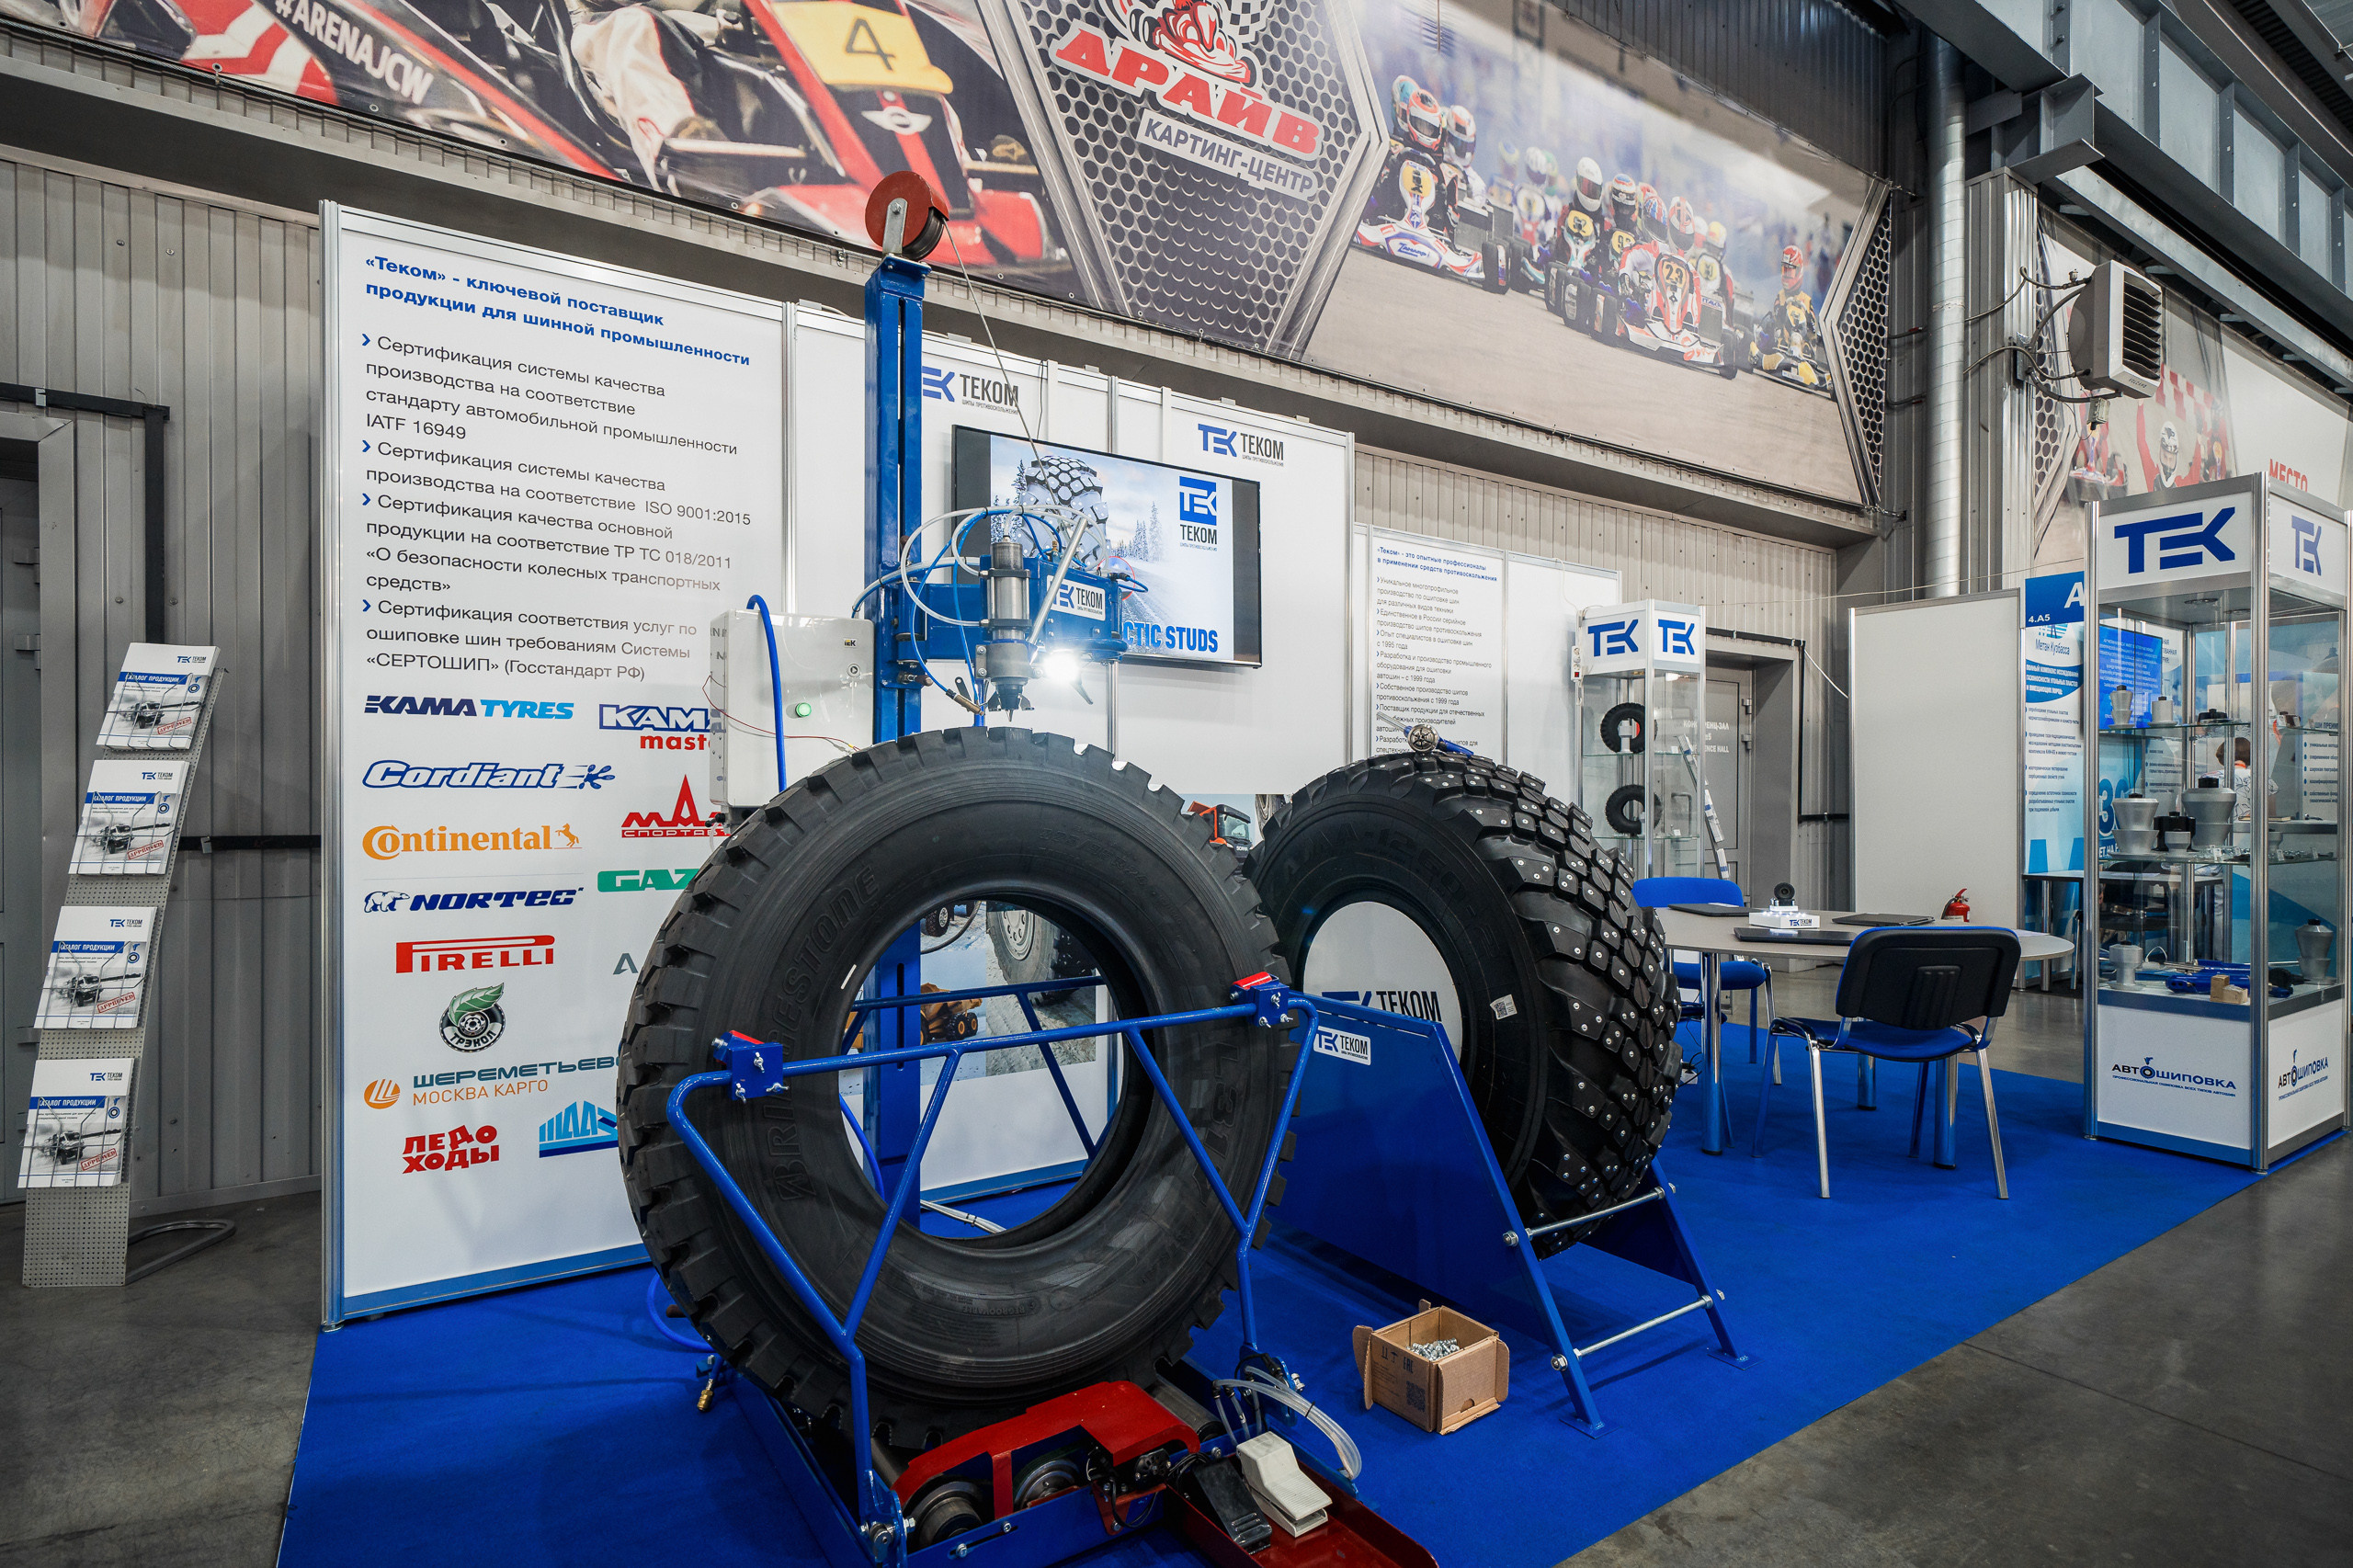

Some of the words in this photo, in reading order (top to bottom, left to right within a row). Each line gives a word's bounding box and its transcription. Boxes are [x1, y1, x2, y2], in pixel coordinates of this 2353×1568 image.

[846, 18, 895, 71] 4
[1056, 28, 1320, 154] АРАЙВ
[1144, 119, 1313, 194] КАРТИНГ-ЦЕНТР
[366, 256, 445, 280] «Теком»
[467, 278, 561, 305] ключевой
[568, 299, 664, 325] поставщик
[367, 284, 475, 313] продукции
[483, 307, 516, 321] для
[524, 314, 594, 335] шинной
[601, 329, 749, 365] промышленности
[378, 336, 511, 370] Сертификация
[518, 363, 588, 383] системы
[596, 376, 665, 396] качества
[367, 364, 494, 392] производства
[501, 385, 519, 397] на
[526, 390, 635, 415] соответствие
[960, 374, 1018, 407] ТЕКОМ
[367, 391, 460, 415] стандарту
[466, 405, 597, 433] автомобильной
[604, 426, 736, 454] промышленности
[368, 414, 405, 430] IATF
[414, 421, 465, 439] 16949
[1198, 424, 1237, 457] ТЕК
[1241, 433, 1284, 460] ТЕКОМ
[378, 442, 511, 471] Сертификация
[518, 463, 589, 481] системы
[596, 473, 665, 491] качества
[367, 471, 494, 494] производства
[501, 486, 520, 497] на
[526, 489, 635, 510] соответствие
[646, 501, 672, 515] ISO
[677, 506, 750, 525] 9001:2015
[1179, 485, 1217, 517] ТЕК
[378, 494, 512, 521] Сертификация
[518, 513, 593, 529] качества
[598, 522, 672, 539] основной
[367, 523, 464, 542] продукции
[472, 533, 492, 544] на
[497, 537, 608, 555] соответствие
[614, 545, 634, 558] ТР
[640, 548, 660, 561] ТС
[665, 551, 730, 568] 018/2011
[1180, 524, 1217, 544] ТЕКОМ
[2114, 506, 2235, 574] ТЕК
[2291, 515, 2322, 576] ТЕК
[367, 548, 391, 561] «О
[397, 550, 521, 572] безопасности
[529, 564, 607, 580] колесных
[612, 572, 720, 590] транспортных
[367, 576, 450, 592] средств»
[1076, 587, 1103, 609] ТЕКОМ
[379, 600, 512, 623] Сертификация
[518, 614, 628, 630] соответствия
[633, 622, 674, 635] услуг
[679, 626, 697, 635] по
[2029, 614, 2051, 622] 4.A5
[367, 630, 459, 643] ошиповке
[466, 635, 500, 646] шин
[506, 637, 615, 653] требованиям
[621, 642, 689, 658] Системы
[1165, 625, 1218, 653] STUDS
[1587, 619, 1639, 657] ТЕК
[1658, 619, 1695, 655] ТЕК
[2036, 638, 2050, 652] Метан
[2051, 641, 2070, 655] Кузбасса
[367, 653, 498, 671] «СЕРТОШИП»
[505, 660, 612, 679] (Госстандарт
[618, 666, 644, 682] РФ)
[364, 695, 477, 716] KAMA
[480, 699, 574, 720] TYRES
[598, 704, 710, 733] KAM
[640, 733, 710, 751] mast
[362, 759, 563, 789] Cordiant
[362, 824, 552, 860] Continental
[409, 889, 576, 912] NORTEC
[396, 935, 555, 974] PIRELLI
[449, 1028, 497, 1050] ТРЭКОЛ
[763, 862, 882, 1204] BRIGESTONE
[1340, 1035, 1369, 1055] ТЕКОМ
[413, 1056, 620, 1089] ШЕРЕМЕТЬЕВ
[2111, 1064, 2236, 1089] АВТОШИПОВКА
[2278, 1057, 2328, 1088] АВТОШИПОВКА
[413, 1086, 489, 1106] МОСКВА
[494, 1079, 548, 1097] КАРГО
[404, 1124, 497, 1154] ЛЕДО
[403, 1145, 500, 1174] ХОДЫ
